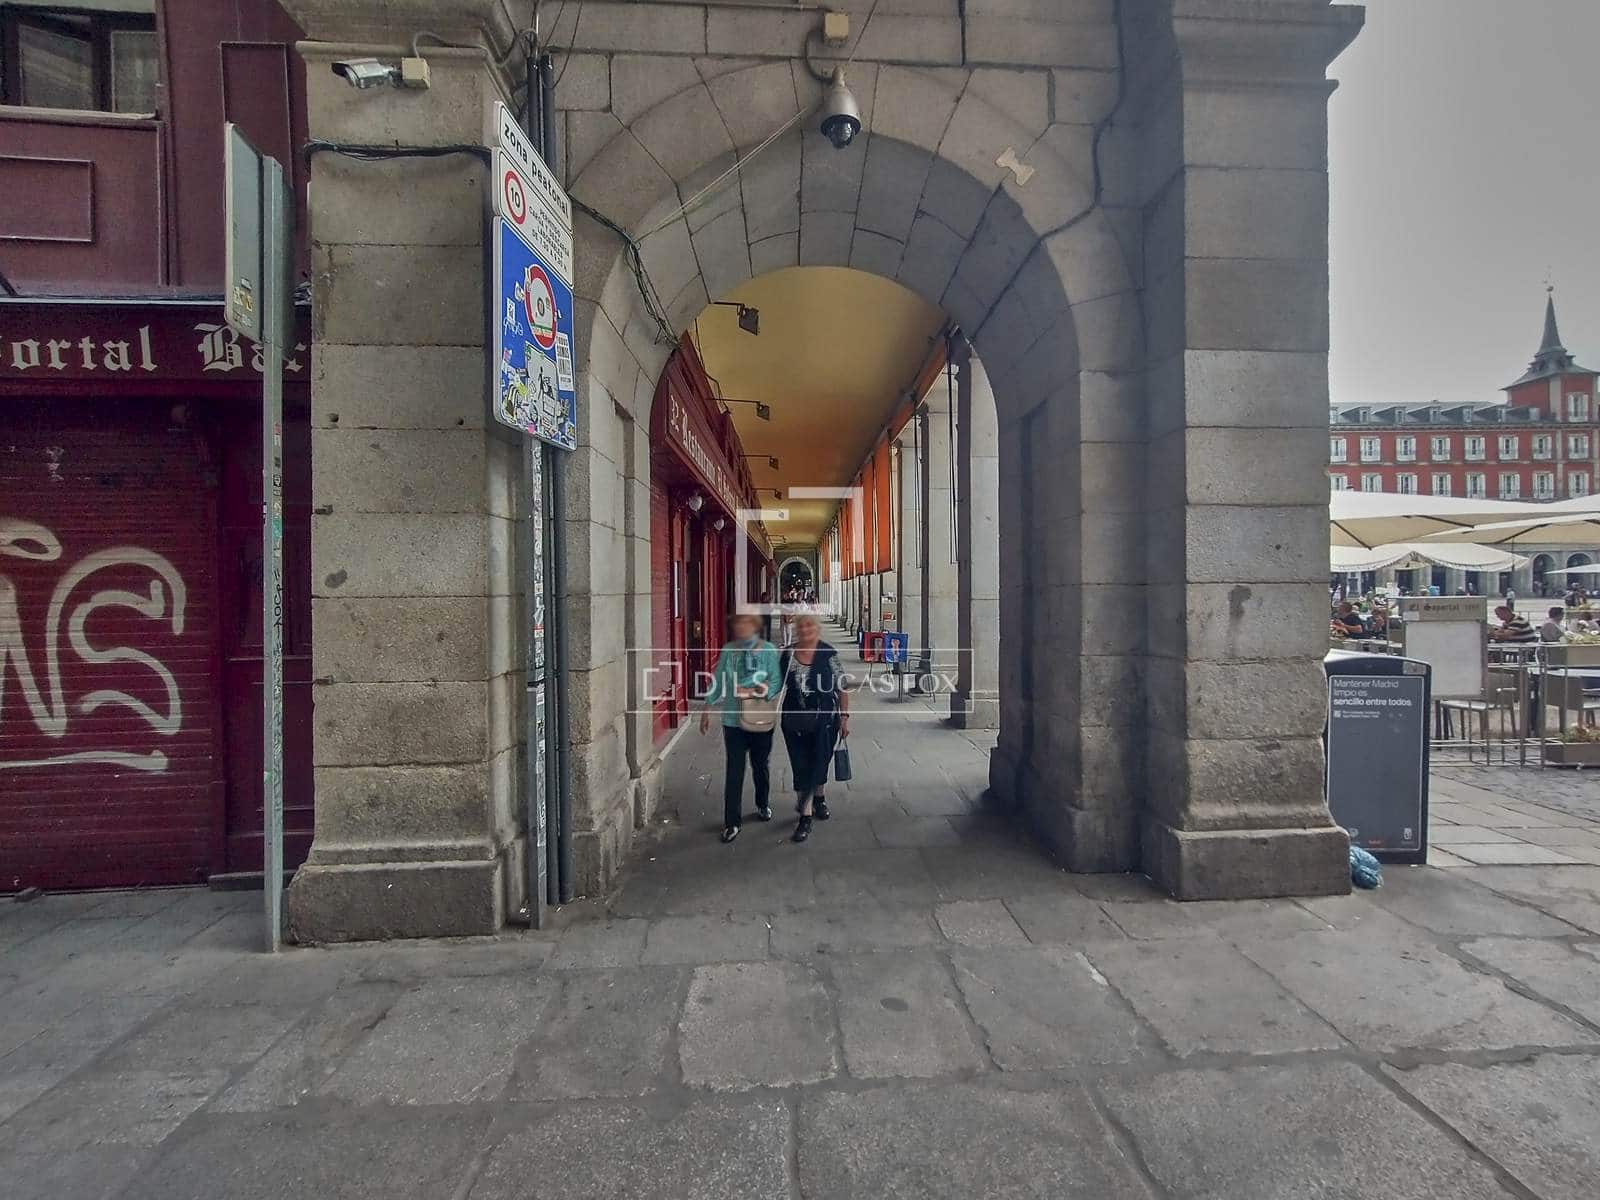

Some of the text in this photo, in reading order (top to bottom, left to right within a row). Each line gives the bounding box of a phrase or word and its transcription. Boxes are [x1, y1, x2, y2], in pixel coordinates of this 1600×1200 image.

[504, 122, 528, 165] zona
[531, 160, 569, 219] peatonal
[510, 187, 521, 208] 10
[0, 325, 158, 372] ortal
[1334, 679, 1399, 689] Mantener Madrid
[1334, 688, 1368, 698] limpio es
[1334, 697, 1364, 706] sencillo
[1365, 697, 1387, 706] entre
